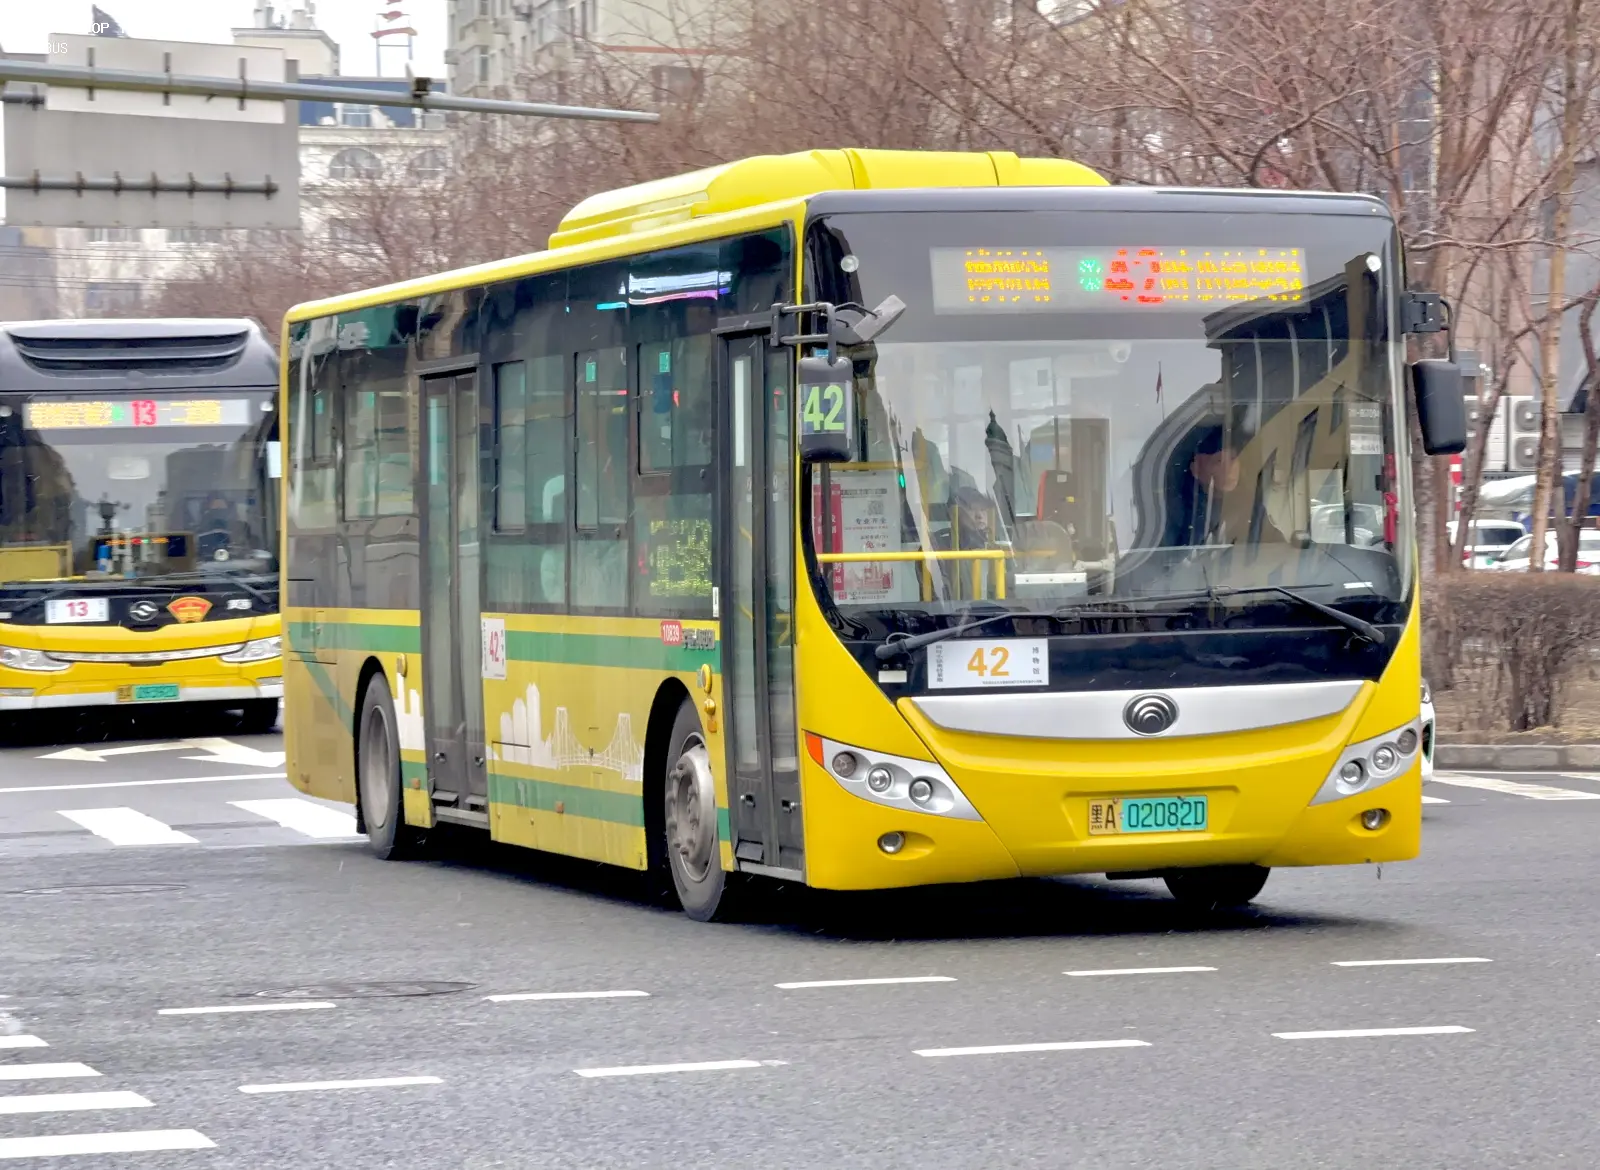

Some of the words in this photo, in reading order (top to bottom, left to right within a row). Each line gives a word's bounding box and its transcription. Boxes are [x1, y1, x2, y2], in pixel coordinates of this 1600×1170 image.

[130, 399, 157, 427] 13
[803, 384, 845, 431] 42
[65, 601, 89, 617] 13
[489, 630, 499, 662] 42
[967, 646, 1010, 677] 42
